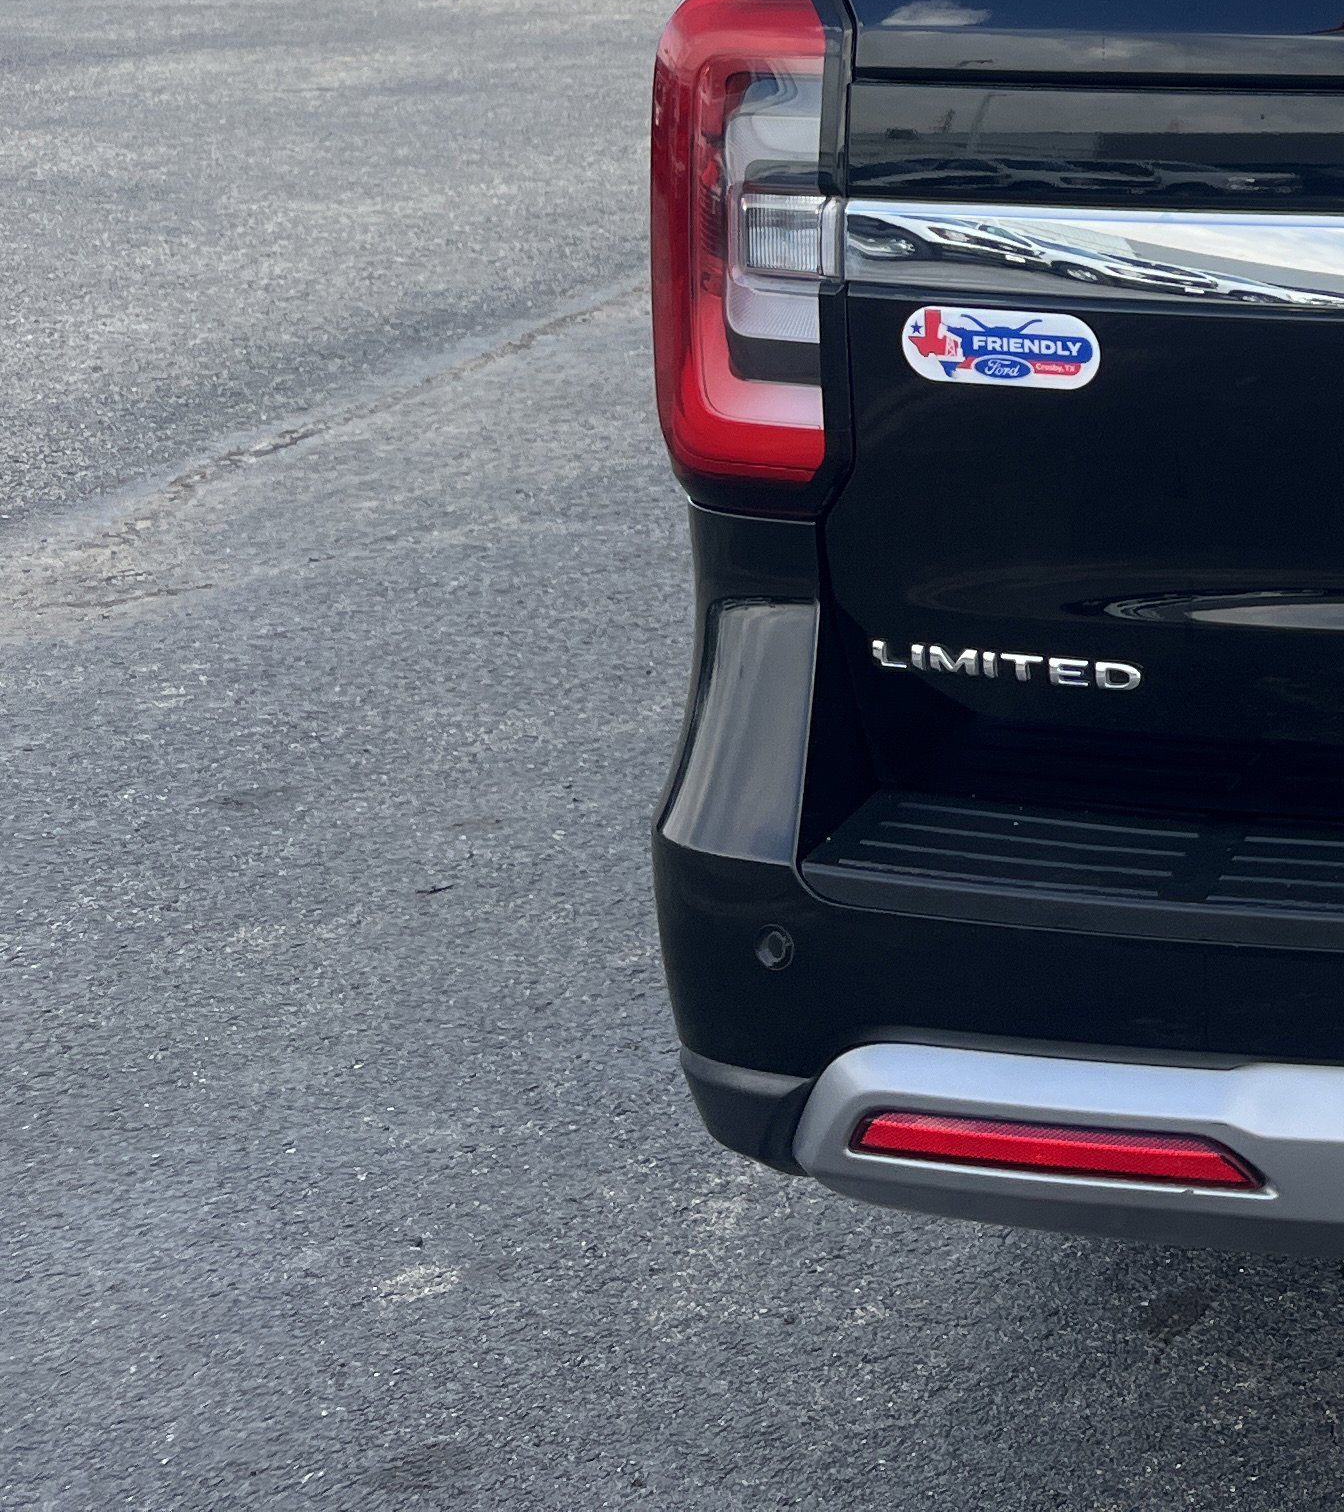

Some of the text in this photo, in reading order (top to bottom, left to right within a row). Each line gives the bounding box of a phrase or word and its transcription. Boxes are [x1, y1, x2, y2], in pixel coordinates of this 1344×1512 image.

[972, 336, 1082, 357] FRIENDLY
[984, 359, 1020, 377] Ford
[871, 639, 1143, 691] LIMITED
